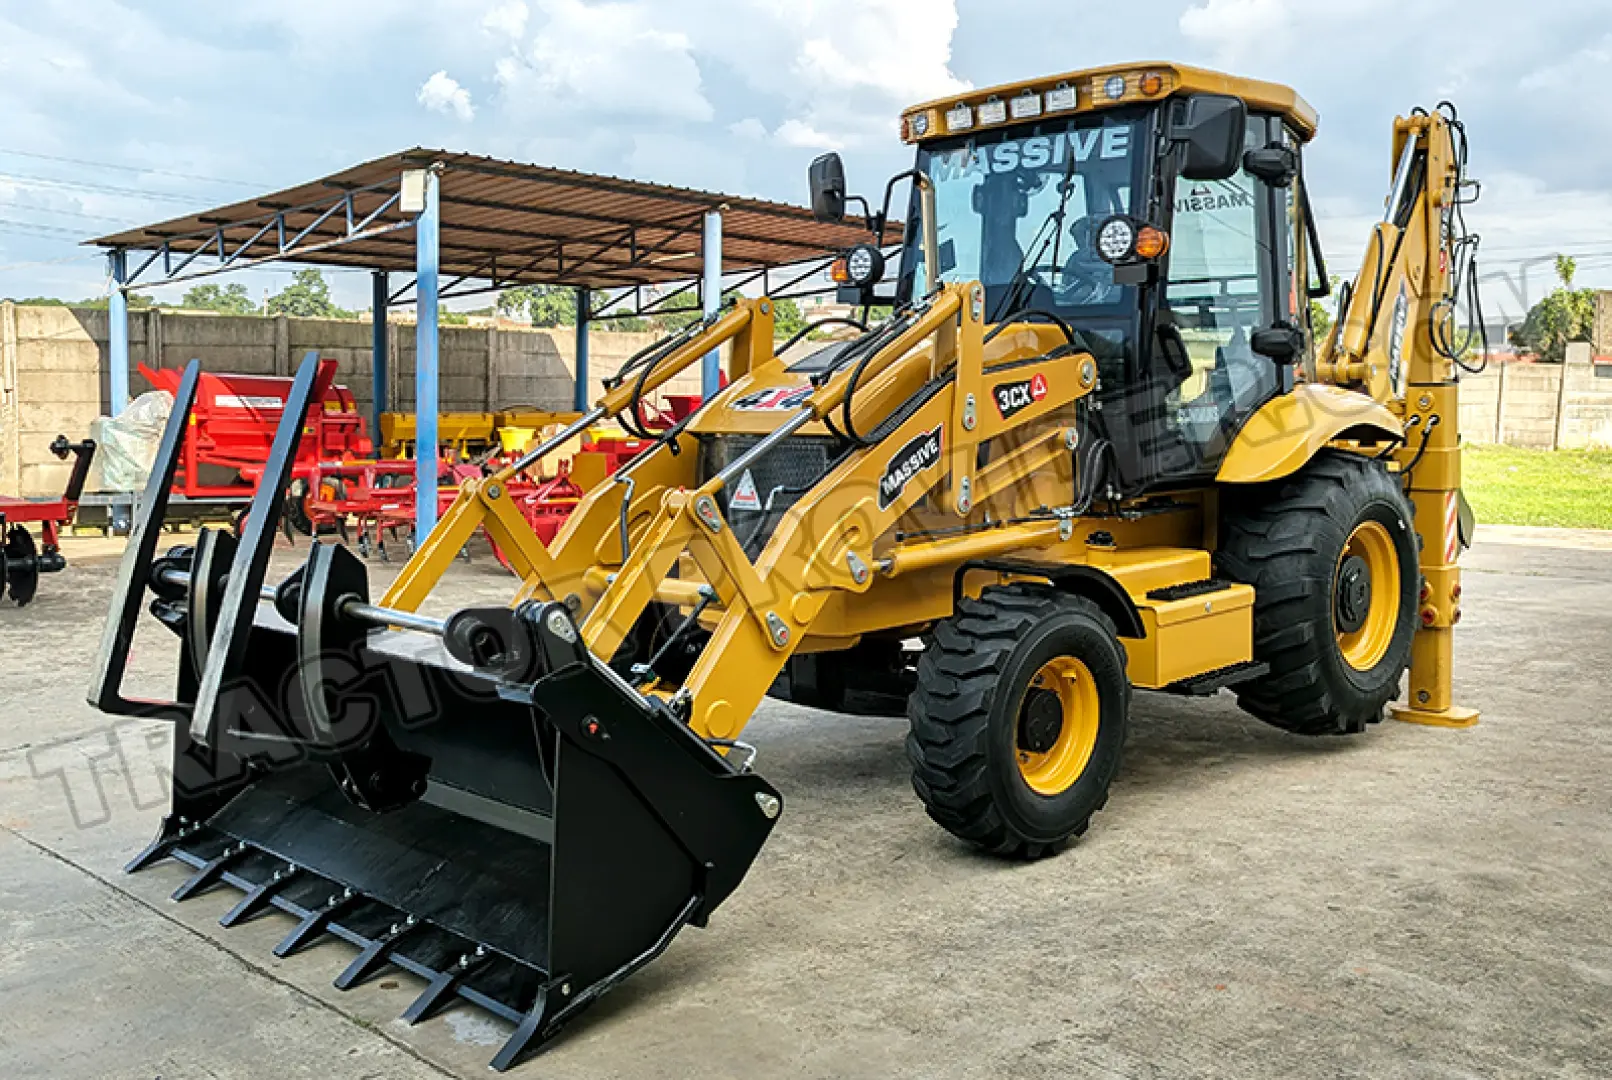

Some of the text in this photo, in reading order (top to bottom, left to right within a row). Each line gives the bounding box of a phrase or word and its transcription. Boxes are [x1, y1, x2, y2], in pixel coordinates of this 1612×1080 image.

[930, 125, 1130, 181] MASSIVE
[999, 383, 1031, 411] 3CX
[882, 437, 938, 496] MASSIVE
